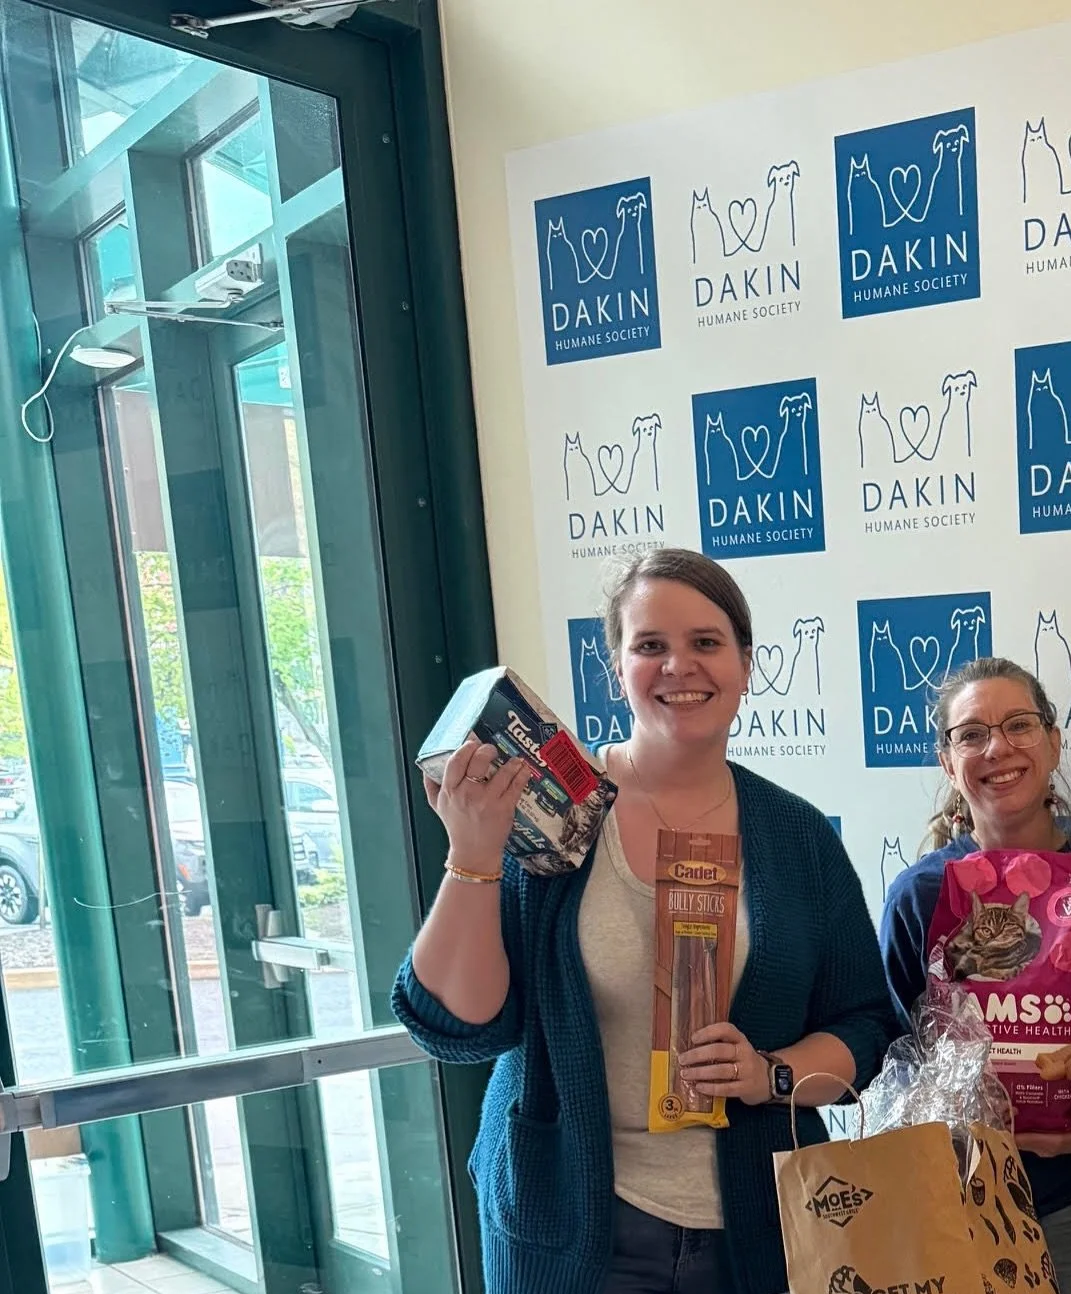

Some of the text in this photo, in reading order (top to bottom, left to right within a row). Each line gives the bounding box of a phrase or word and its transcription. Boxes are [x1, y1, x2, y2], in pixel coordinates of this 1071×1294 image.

[851, 231, 968, 280] DAKIN
[696, 261, 800, 306] DAKIN
[853, 273, 968, 302] HUMANE SOCIETY
[552, 288, 649, 332] DAKIN
[697, 300, 802, 328] HUMANE SOCIETY
[555, 326, 650, 351] HUMANE SOCIETY
[863, 472, 975, 512] DAKIN
[709, 490, 813, 527] DAKIN
[569, 504, 664, 540] DAKIN
[864, 513, 976, 533] HUMANE SOCIETY
[711, 527, 814, 547] HUMANE SOCIETY
[572, 545, 617, 559] HUMANE
[727, 744, 826, 757] HUMANE SOCIETY
[876, 743, 929, 754] HUMANE
[674, 864, 718, 881] Cadet
[668, 891, 725, 913] BULLY STICKS
[967, 991, 1042, 1024] AMS
[1025, 1026, 1071, 1036] HEALTH
[665, 1099, 674, 1111] 3
